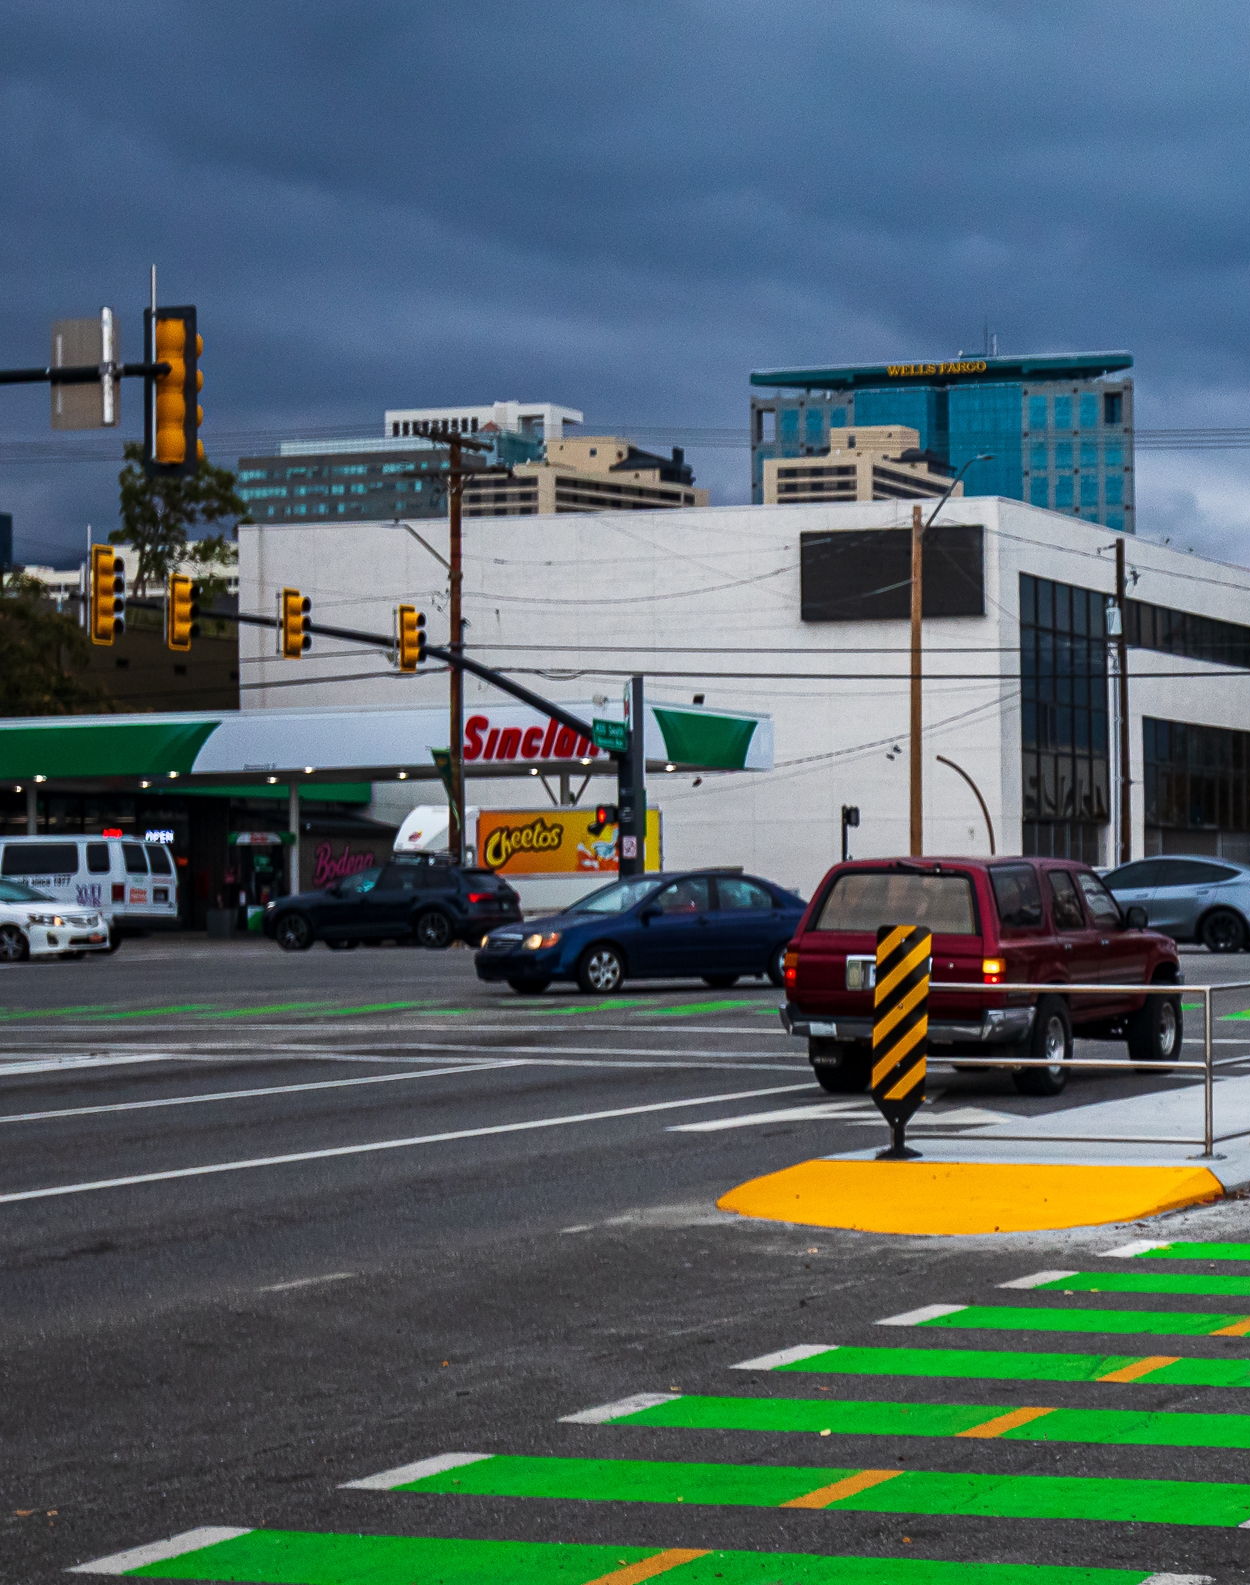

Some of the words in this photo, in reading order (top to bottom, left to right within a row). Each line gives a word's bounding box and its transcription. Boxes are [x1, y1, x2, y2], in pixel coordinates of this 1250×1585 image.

[886, 364, 936, 377] WELLS
[939, 361, 987, 375] FARGO
[145, 829, 174, 844] OPEN
[486, 819, 563, 868] Cheetos
